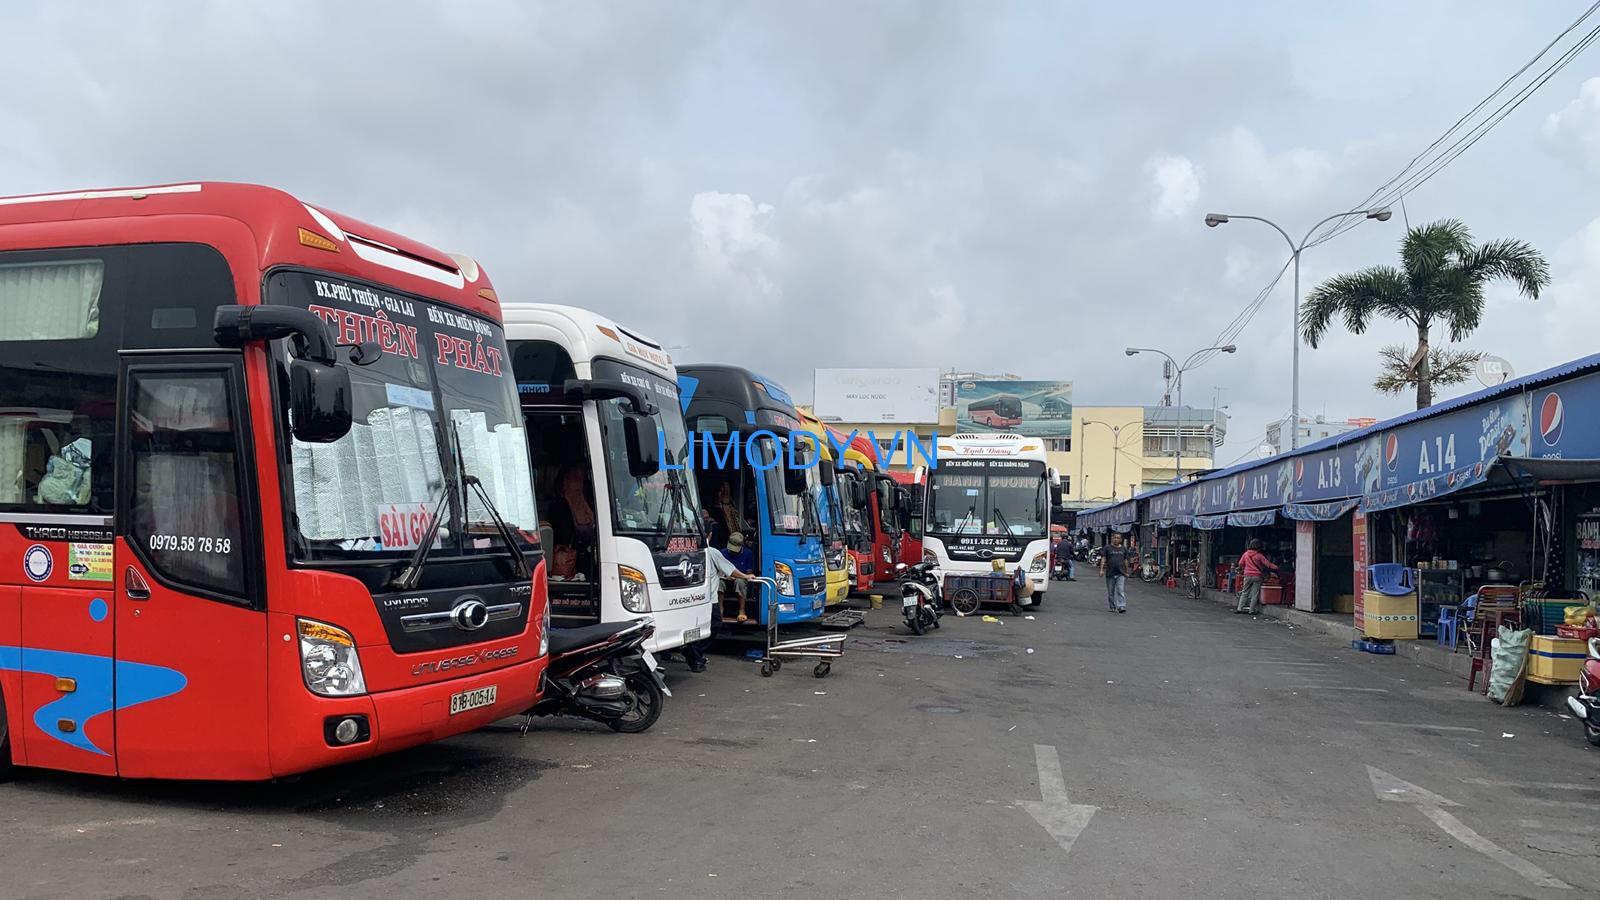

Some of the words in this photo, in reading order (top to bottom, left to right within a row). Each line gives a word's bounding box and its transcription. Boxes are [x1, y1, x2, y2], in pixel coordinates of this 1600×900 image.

[352, 288, 381, 311] THIỆN
[385, 296, 400, 314] GIA
[400, 301, 416, 318] LAI
[444, 312, 456, 327] XE
[434, 333, 503, 378] PHÁT
[1418, 433, 1456, 475] A.14
[1252, 474, 1269, 500] A.12
[1317, 456, 1341, 490] A.13
[26, 526, 66, 539] THACO
[381, 504, 409, 548] SÀI
[409, 503, 442, 546] GÒ
[1576, 519, 1599, 539] BÁNH
[149, 534, 195, 552] 0979.58
[198, 536, 213, 552] 78
[215, 538, 231, 554] 58
